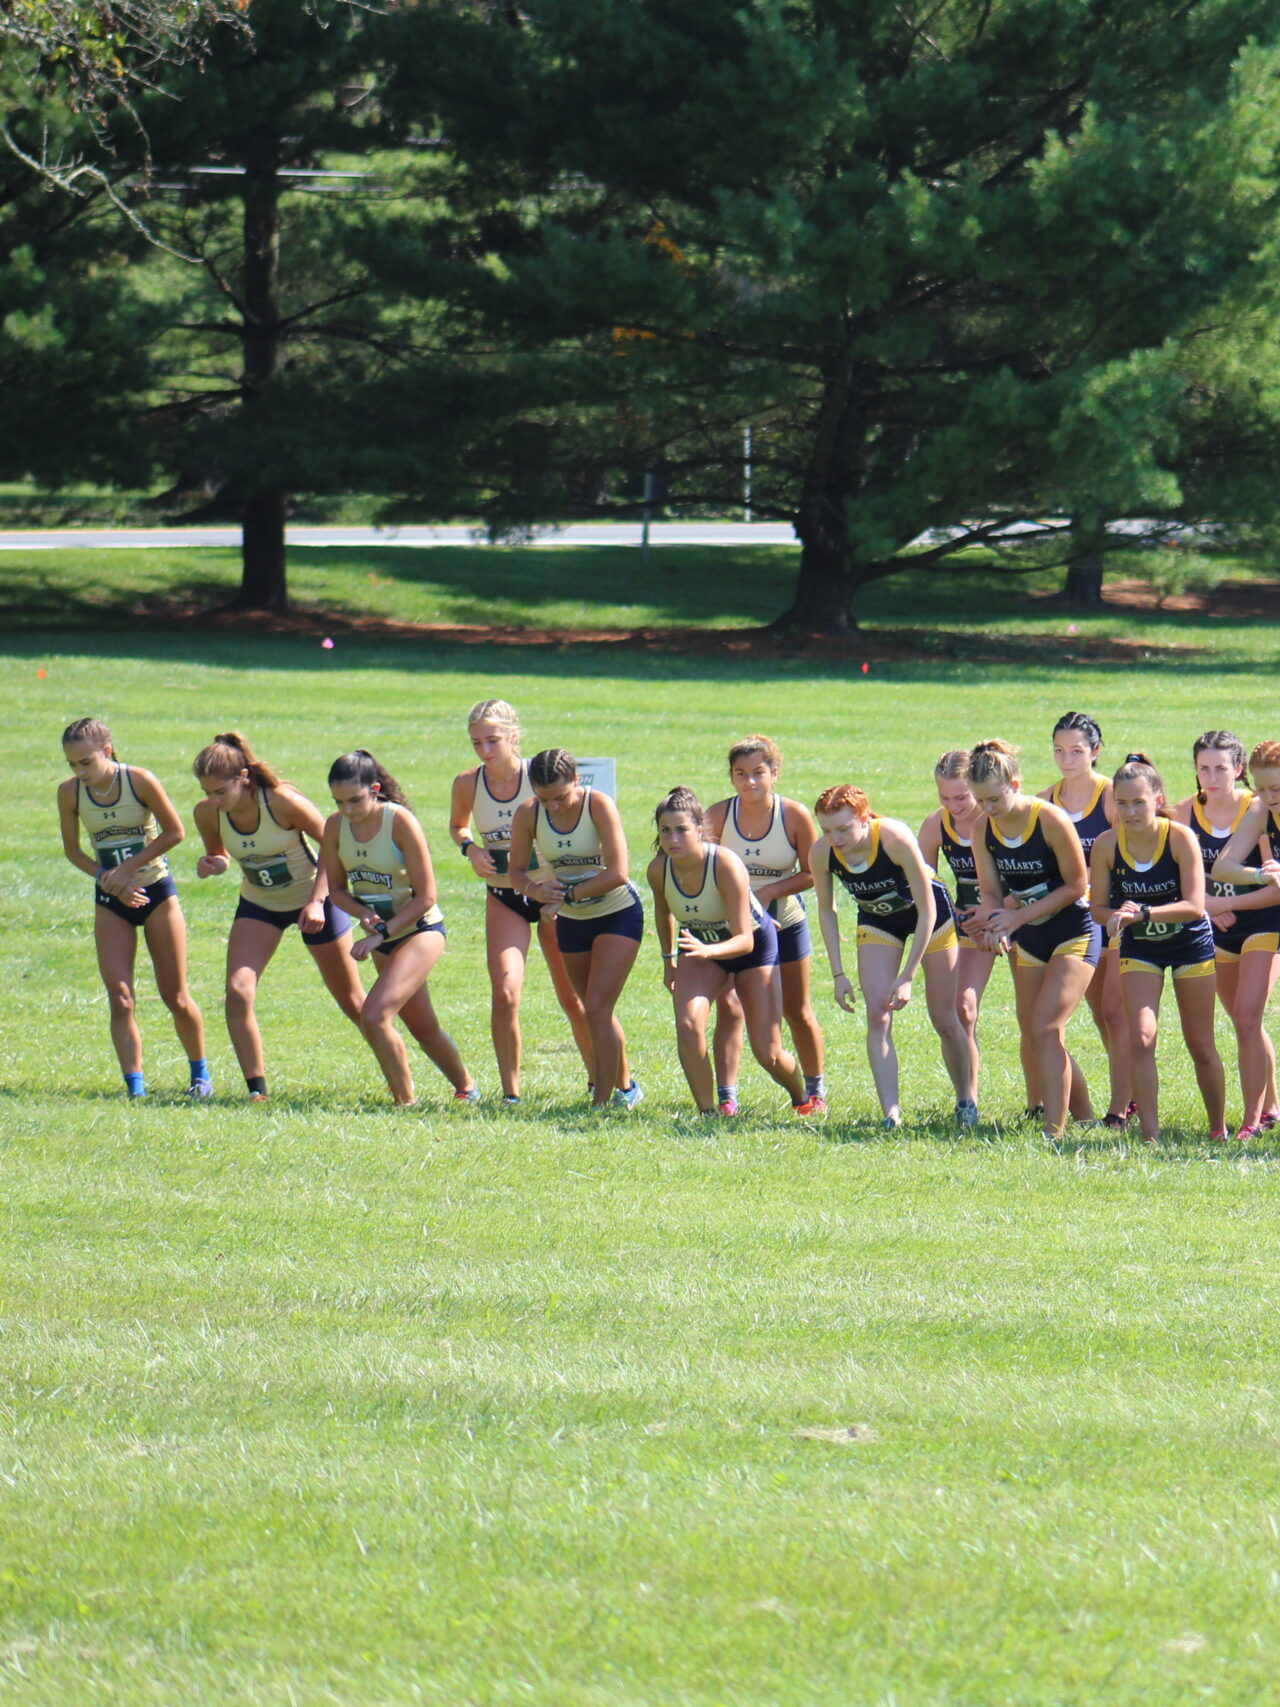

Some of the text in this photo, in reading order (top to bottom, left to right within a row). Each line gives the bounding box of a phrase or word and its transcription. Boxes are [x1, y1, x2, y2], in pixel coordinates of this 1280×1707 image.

[1004, 859, 1043, 871] MARY'S
[258, 869, 274, 887] 8
[360, 871, 393, 890] MOUNT
[853, 878, 896, 893] MARY'S
[1133, 879, 1177, 893] MARY'S
